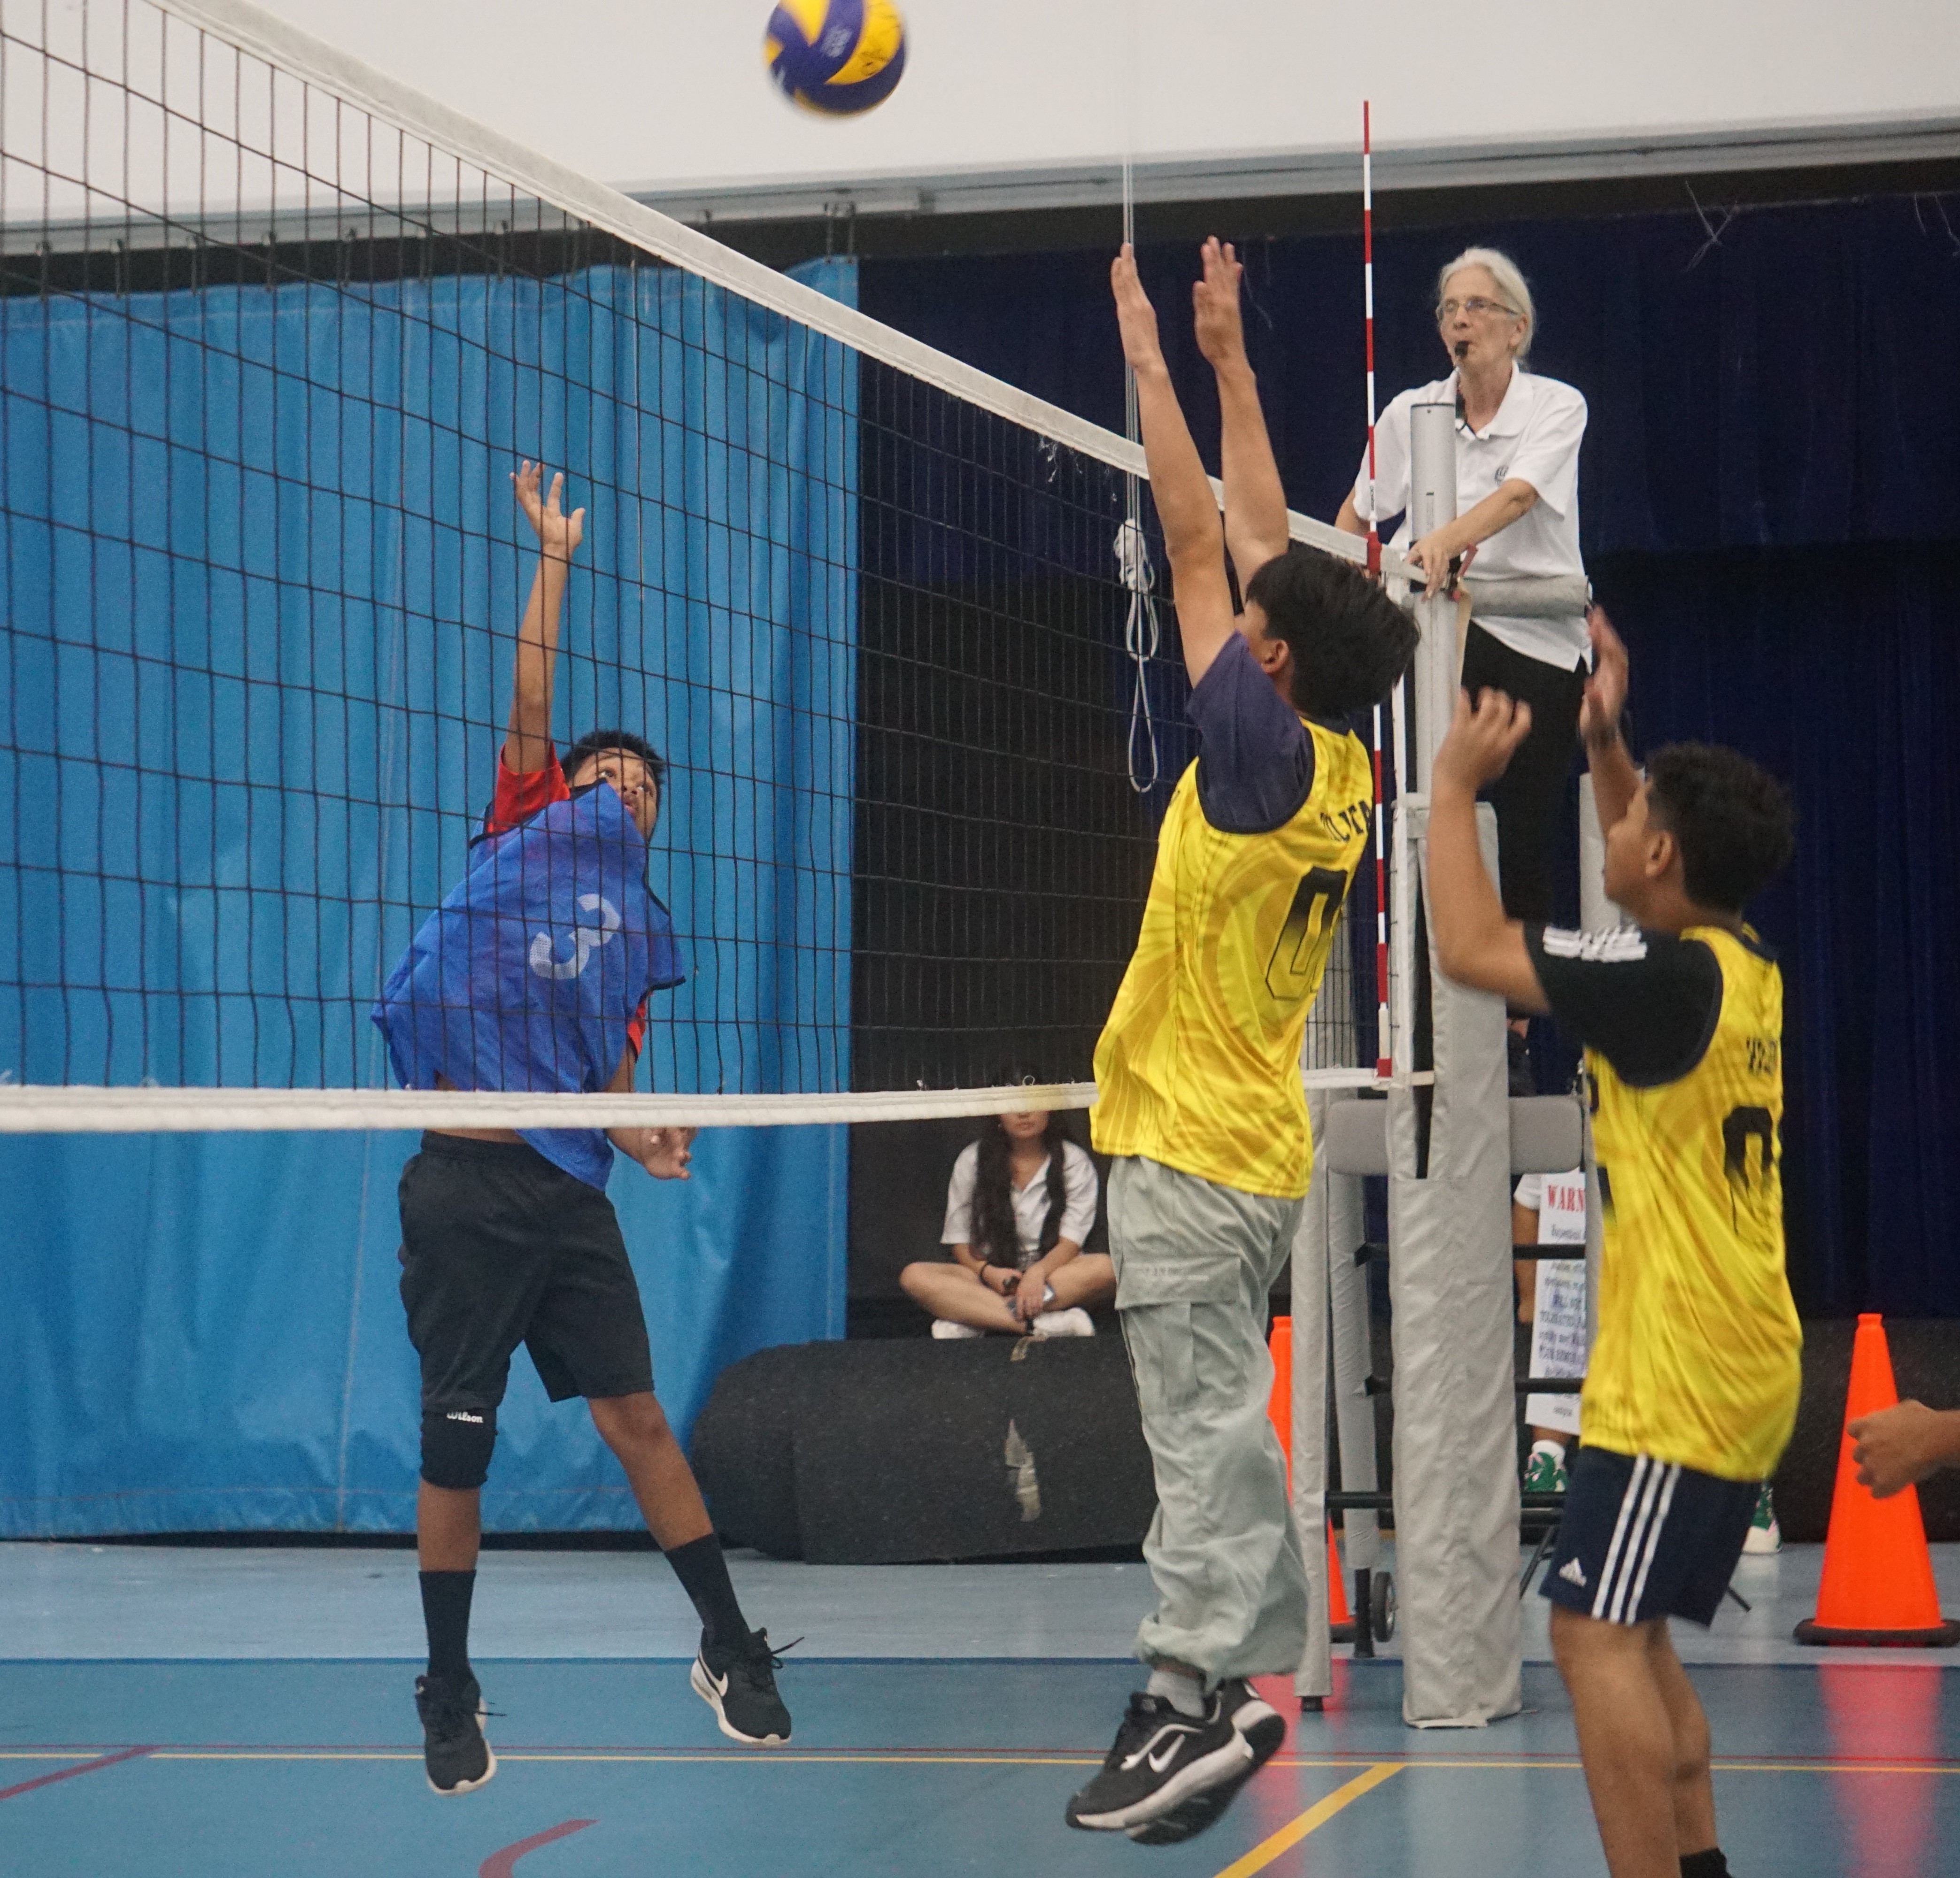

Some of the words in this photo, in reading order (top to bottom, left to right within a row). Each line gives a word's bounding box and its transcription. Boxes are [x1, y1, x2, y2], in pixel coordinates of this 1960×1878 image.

[529, 893, 621, 979] 3
[1266, 866, 1348, 1000] 0
[447, 1411, 483, 1423] Wilson
